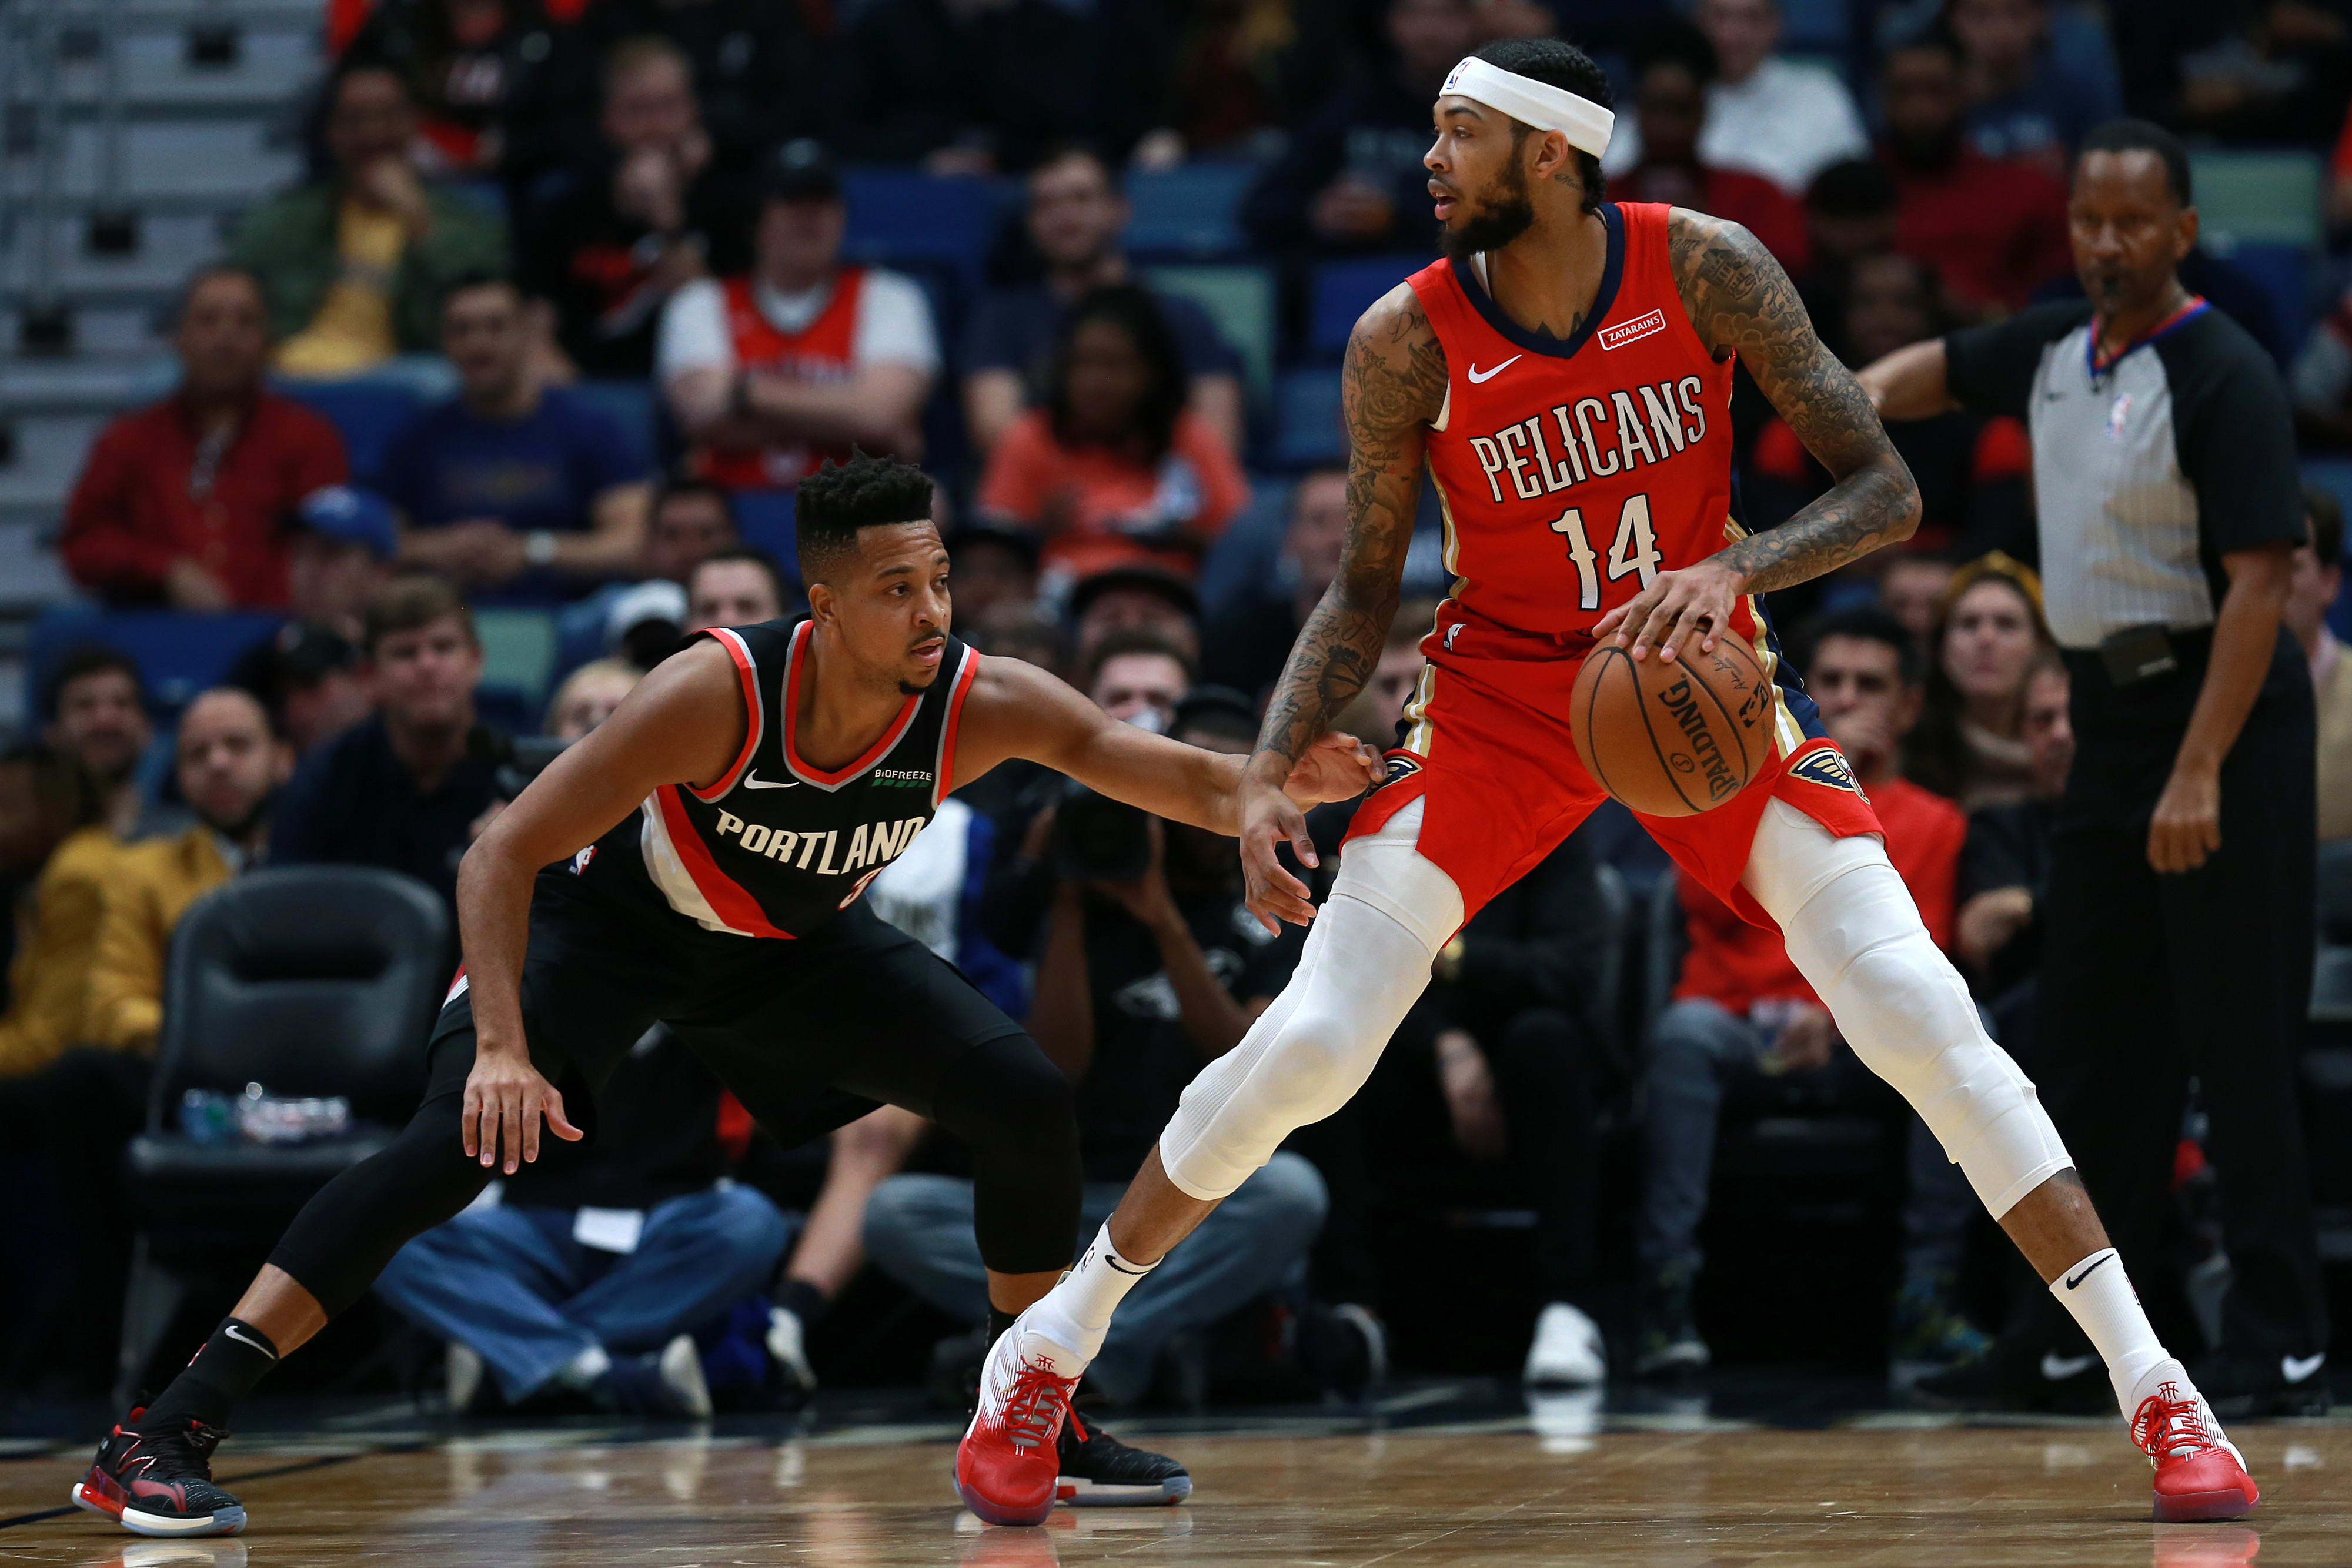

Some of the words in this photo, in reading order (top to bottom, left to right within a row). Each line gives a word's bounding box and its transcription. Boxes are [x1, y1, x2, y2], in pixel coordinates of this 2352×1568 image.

[1608, 316, 1660, 342] ZATARAIN'S
[1469, 375, 1706, 503] PELICANS
[1550, 493, 1663, 611] 14
[1658, 679, 1741, 802] SPALDING
[716, 807, 926, 875] PORTLAND
